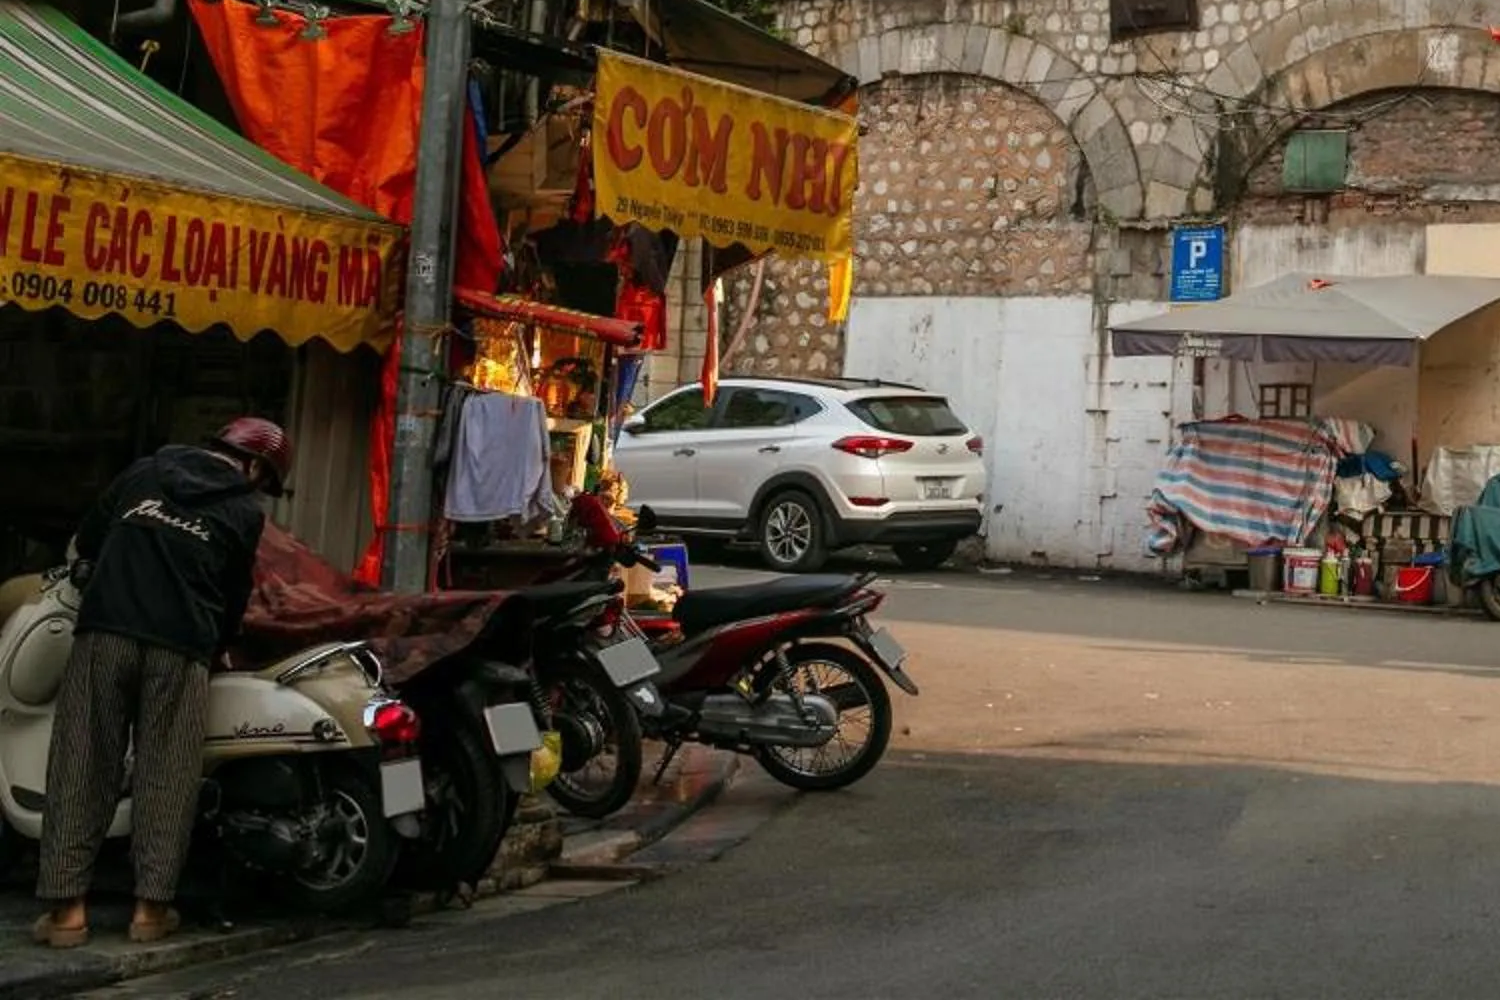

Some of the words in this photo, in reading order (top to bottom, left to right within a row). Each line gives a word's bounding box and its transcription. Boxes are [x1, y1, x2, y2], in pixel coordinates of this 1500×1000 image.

[606, 85, 734, 195] CƠM
[20, 171, 71, 267] LẺ
[83, 188, 153, 279] CÁC
[160, 214, 241, 303] LOẠI
[249, 215, 331, 304] VÀNG
[1189, 241, 1207, 269] P
[82, 281, 128, 311] 008
[133, 289, 177, 317] 441
